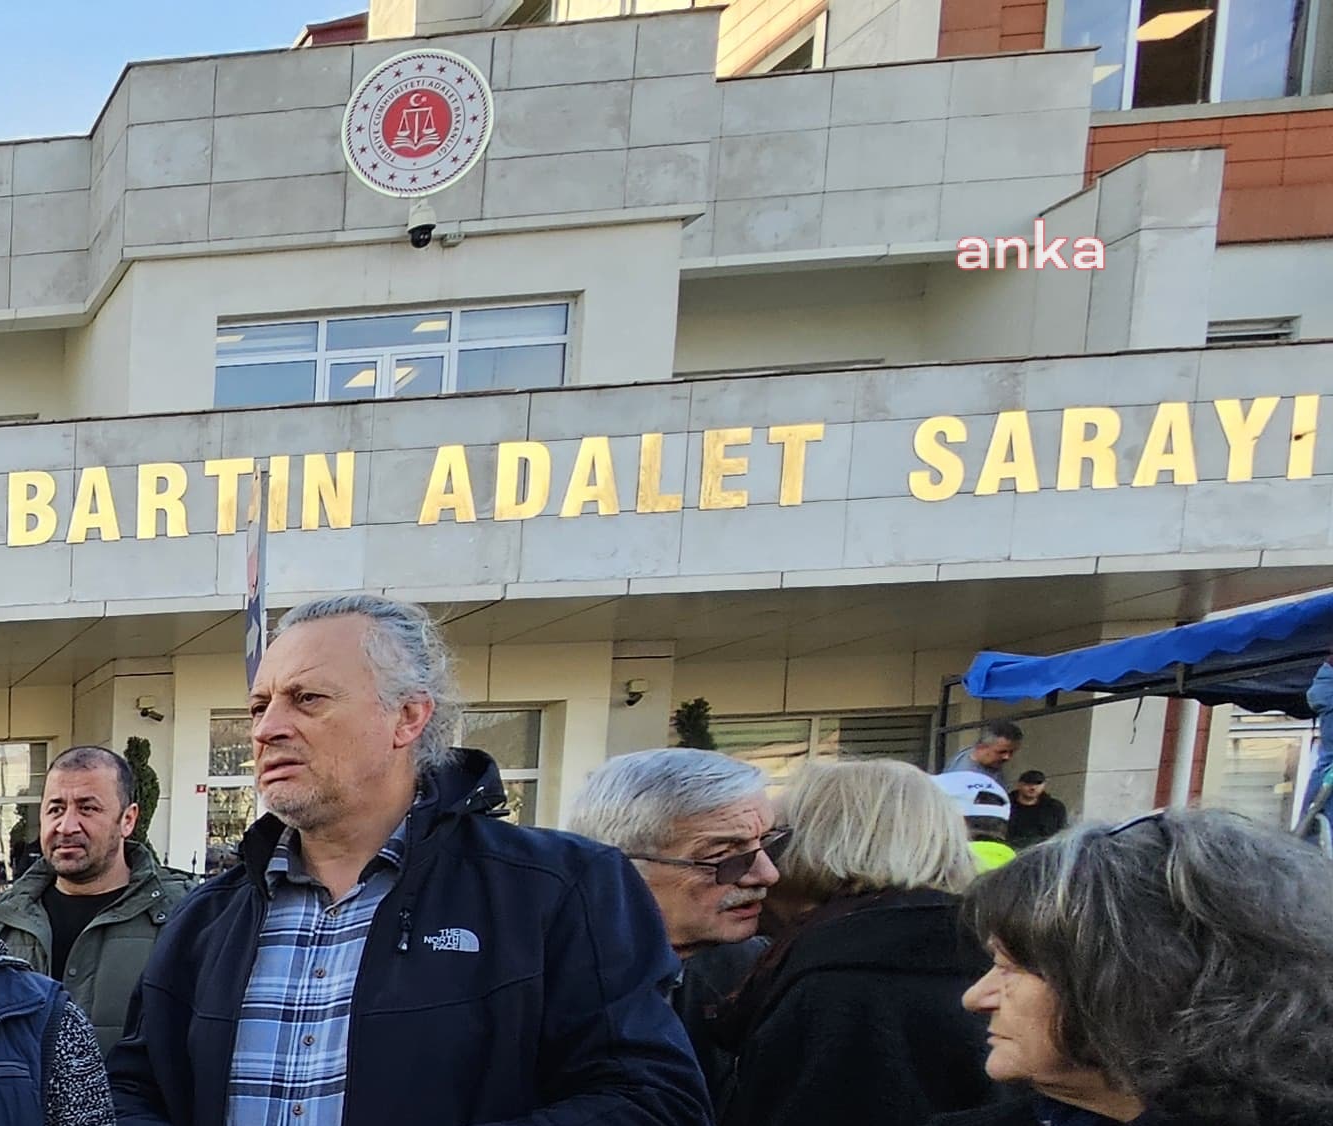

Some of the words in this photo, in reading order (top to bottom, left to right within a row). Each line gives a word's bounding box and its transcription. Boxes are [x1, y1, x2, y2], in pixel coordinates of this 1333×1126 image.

[6, 450, 355, 549] BARTIN
[418, 422, 825, 526] ADALET
[907, 393, 1322, 503] SARAYI
